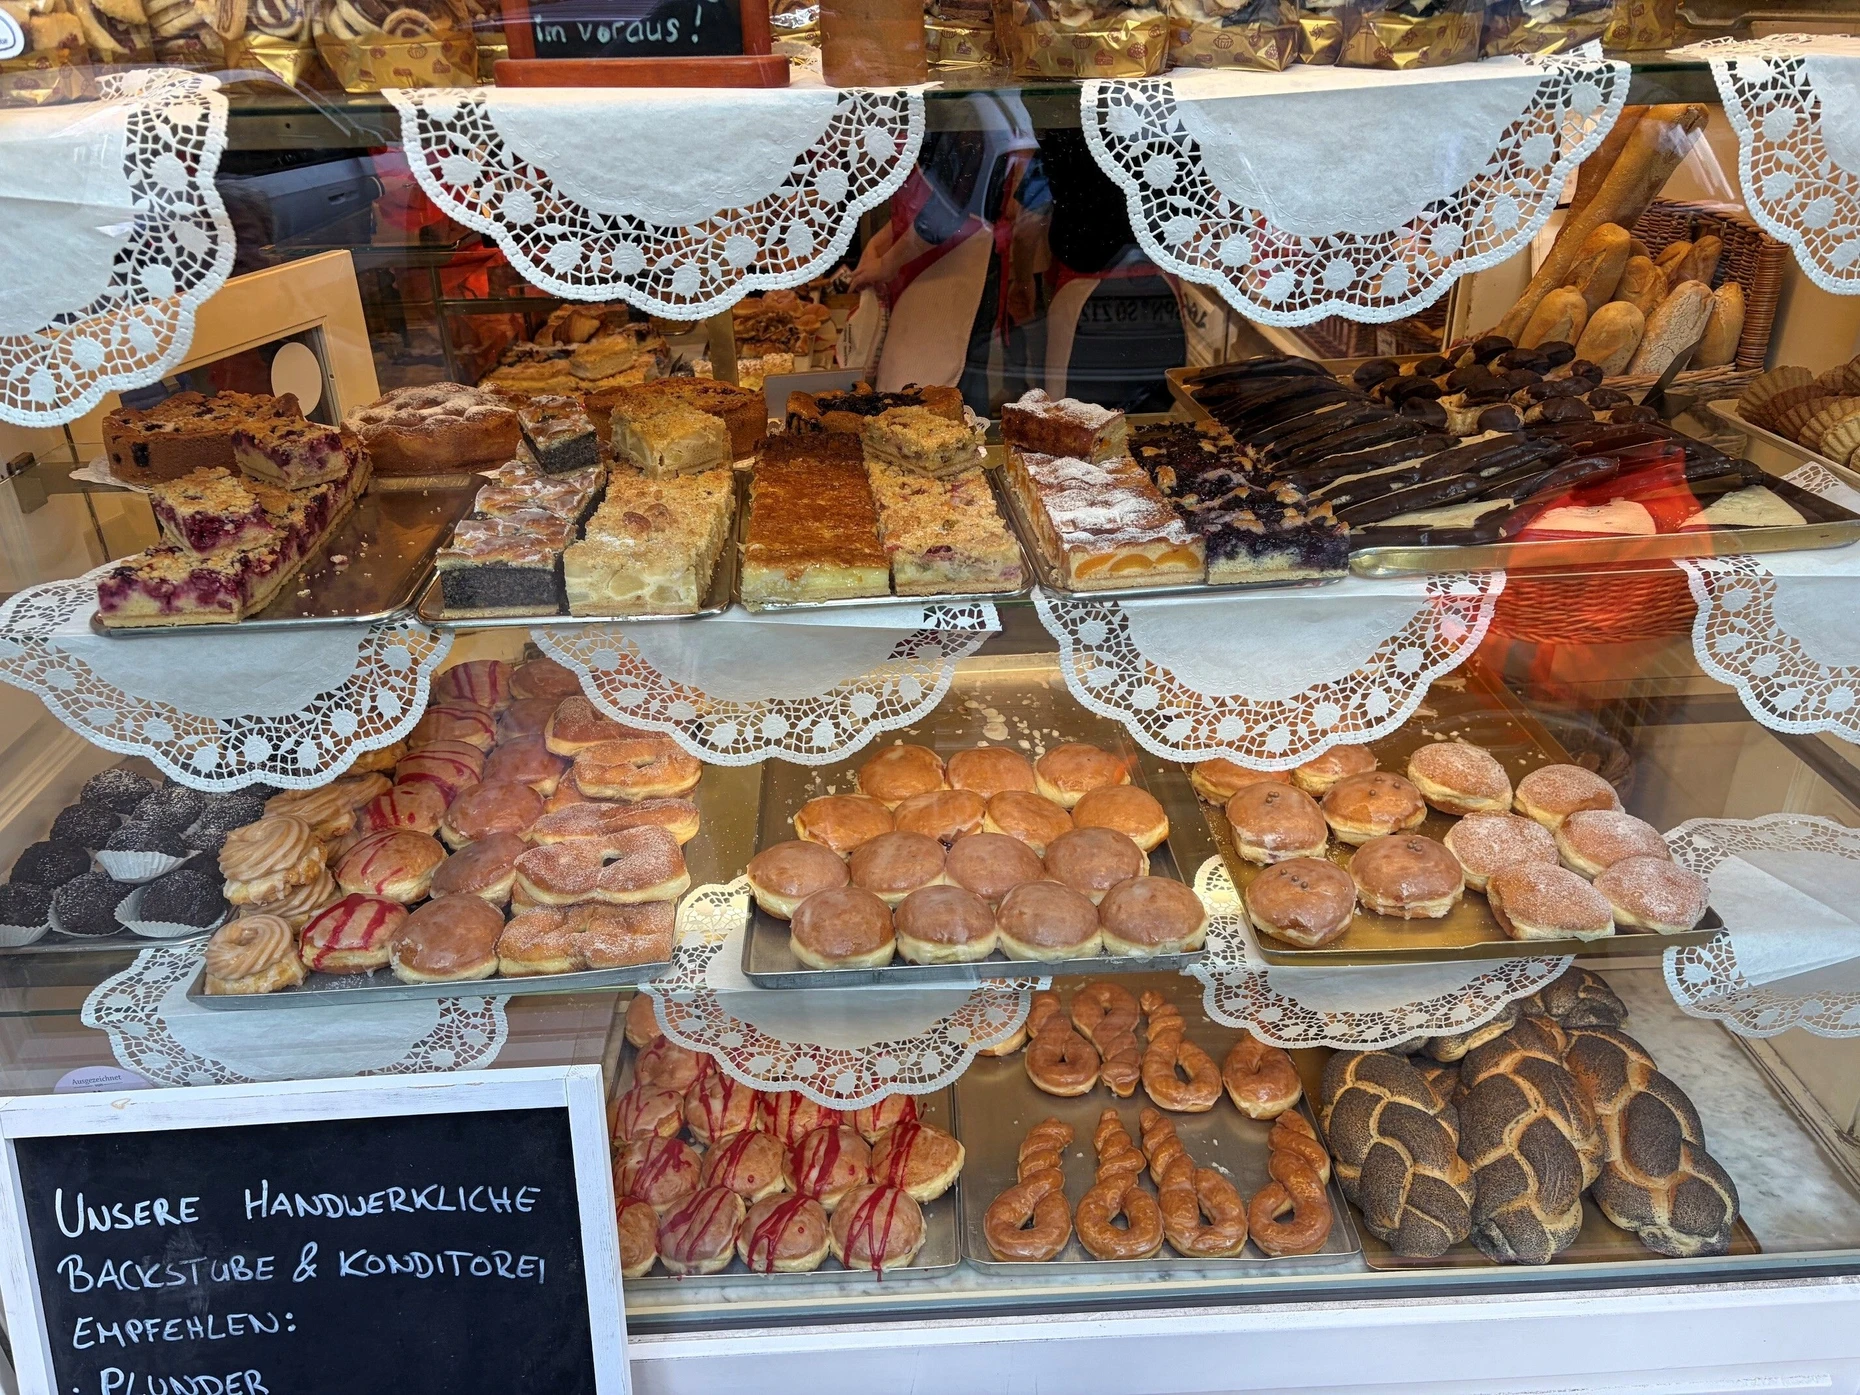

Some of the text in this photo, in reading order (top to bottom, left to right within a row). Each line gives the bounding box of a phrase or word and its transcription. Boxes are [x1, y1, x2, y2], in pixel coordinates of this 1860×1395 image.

[535, 14, 567, 43] im
[72, 1074, 122, 1085] Ausgezeichnet
[55, 1179, 541, 1238] UNSERE HANDWERKLICHE
[56, 1241, 546, 1292] BACKSTUBE & KONDITOREI
[73, 1312, 296, 1349] EMPFEHLEN:
